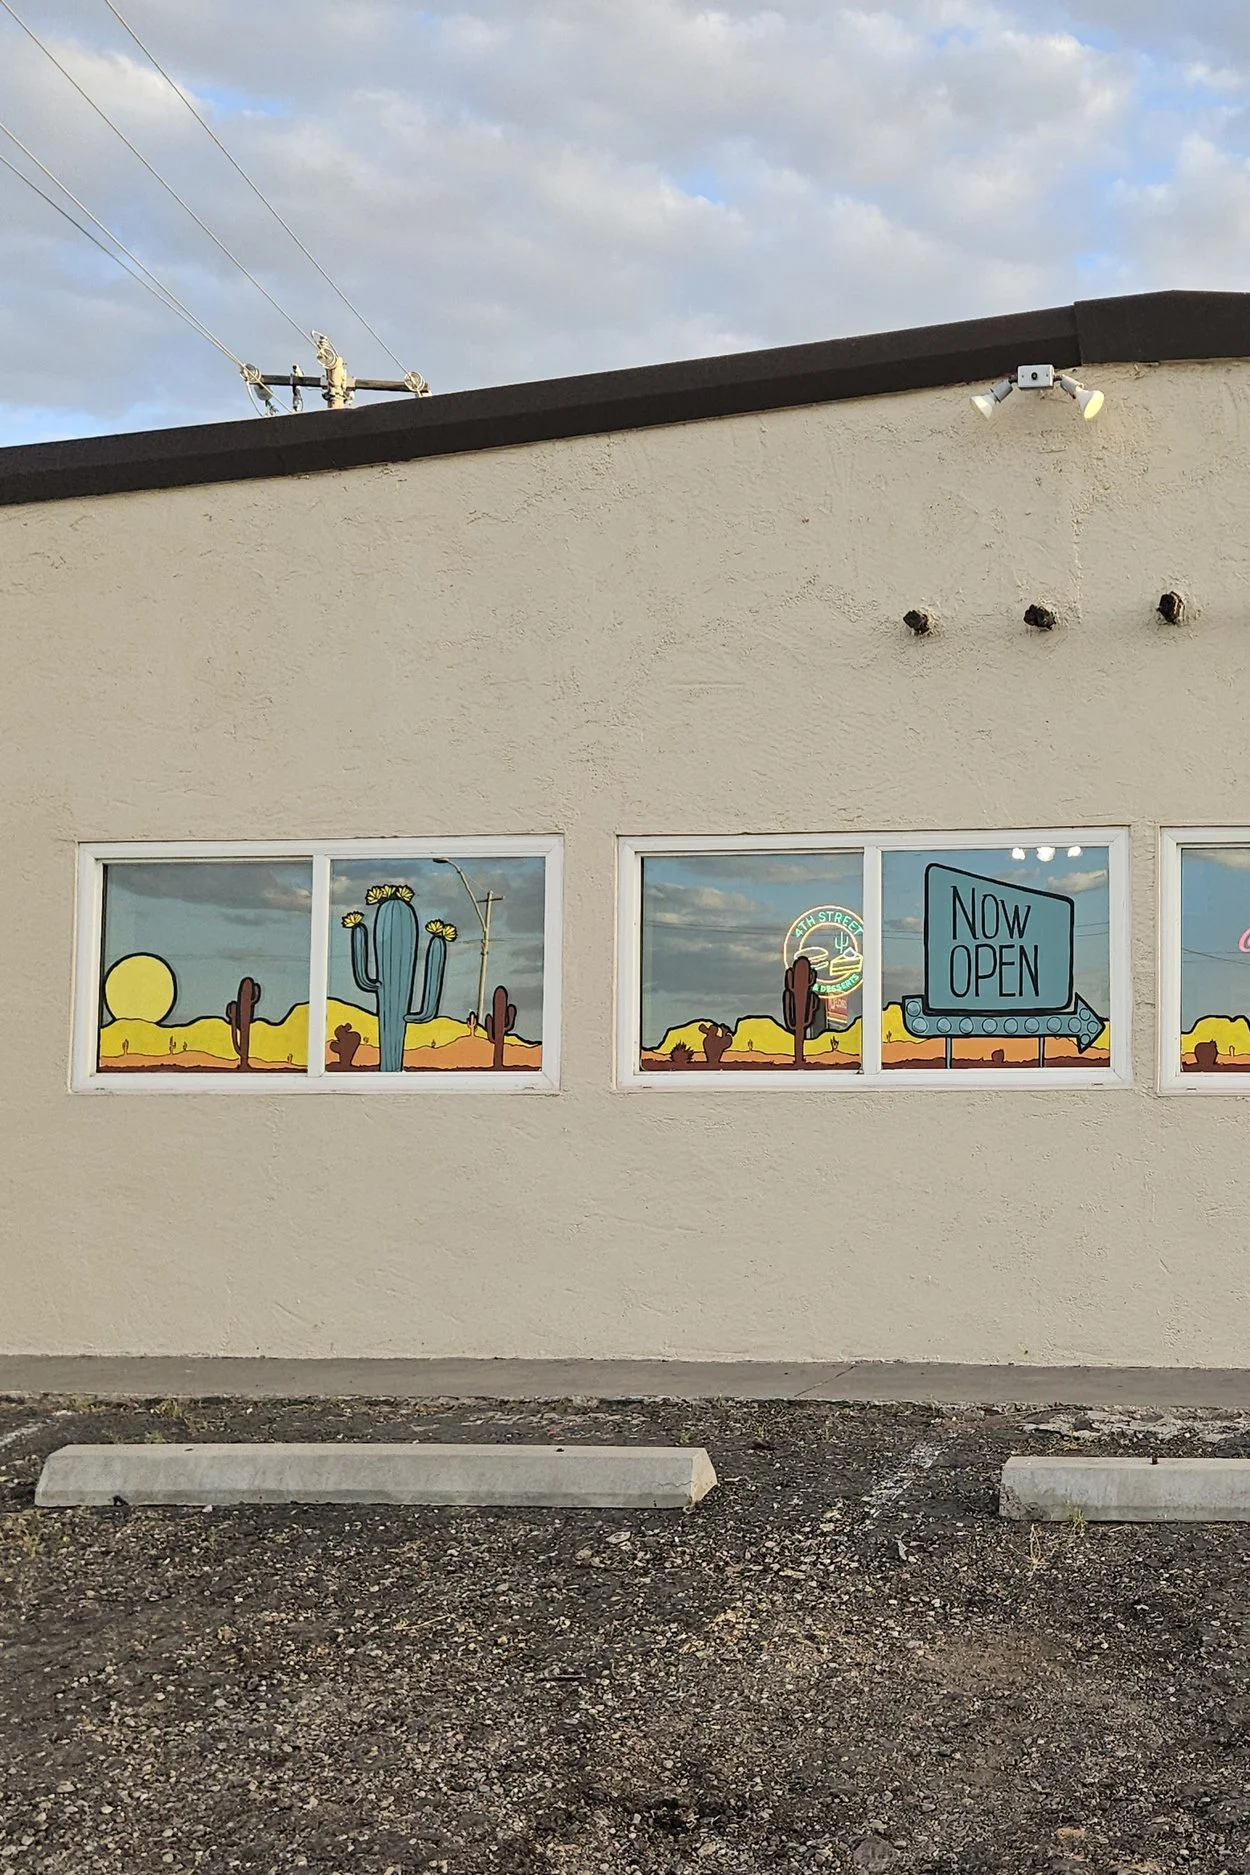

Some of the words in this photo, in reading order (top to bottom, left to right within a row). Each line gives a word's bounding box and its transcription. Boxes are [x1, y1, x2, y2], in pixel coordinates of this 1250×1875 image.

[795, 915, 816, 938] 4TH
[818, 911, 864, 936] STREET
[950, 885, 1032, 940] NOW
[820, 973, 860, 993] DESSERTS
[949, 943, 1040, 998] OPEN
